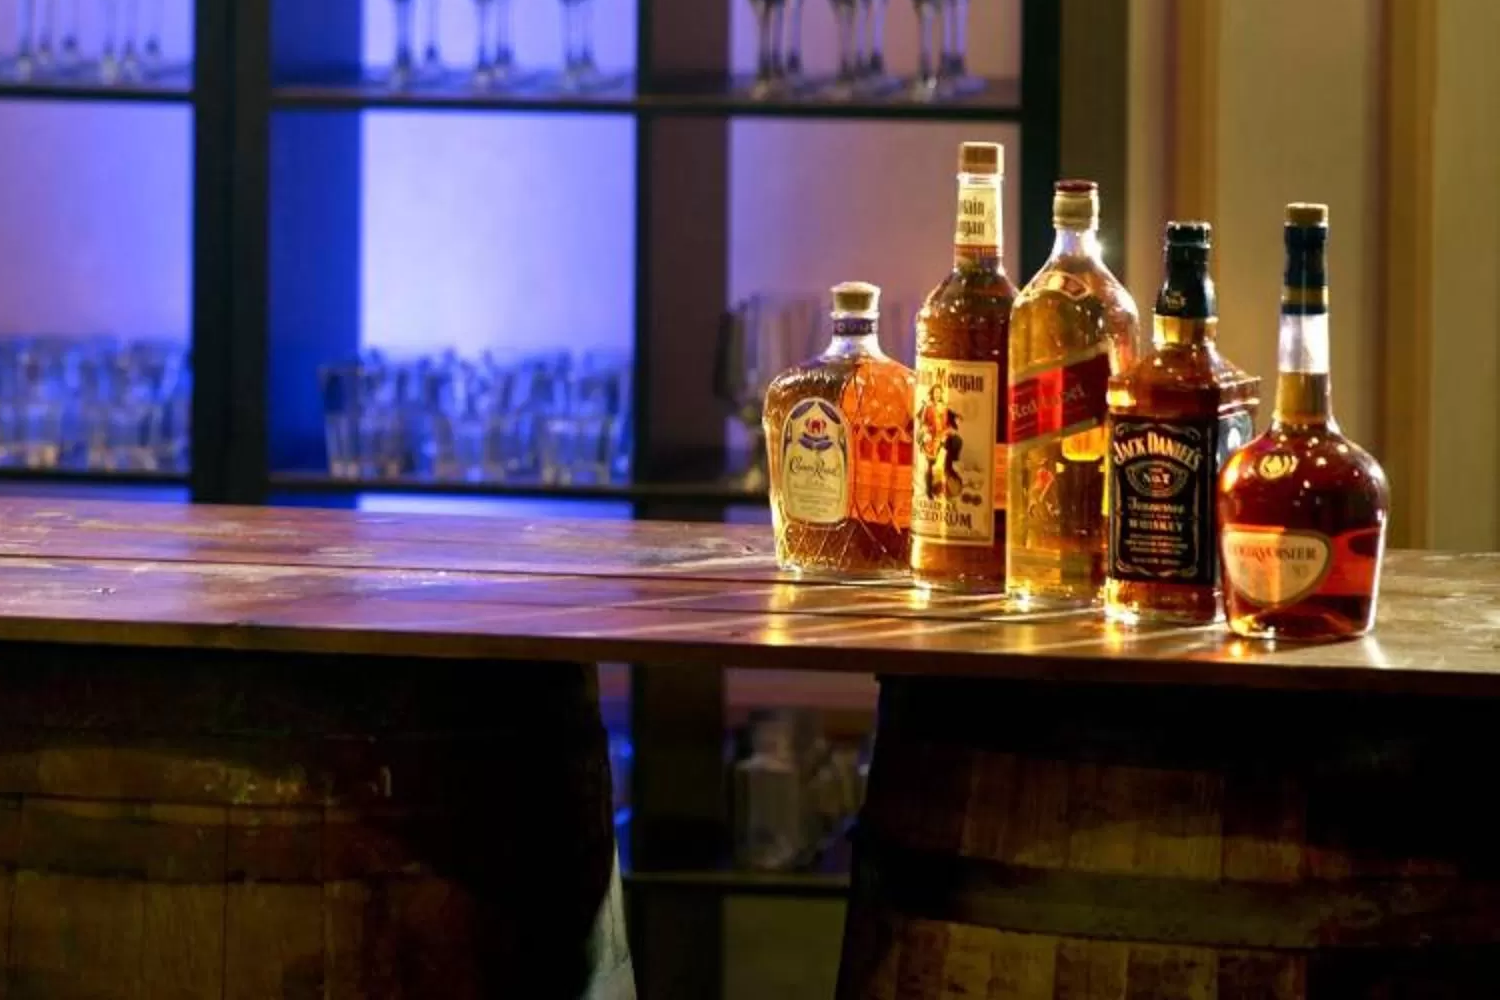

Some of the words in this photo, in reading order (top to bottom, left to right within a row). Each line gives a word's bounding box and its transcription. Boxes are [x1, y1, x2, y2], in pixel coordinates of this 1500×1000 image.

[936, 367, 985, 394] Morgan
[1112, 436, 1147, 466] JACK
[1147, 431, 1204, 473] DANIEL'S
[942, 510, 973, 530] RUM
